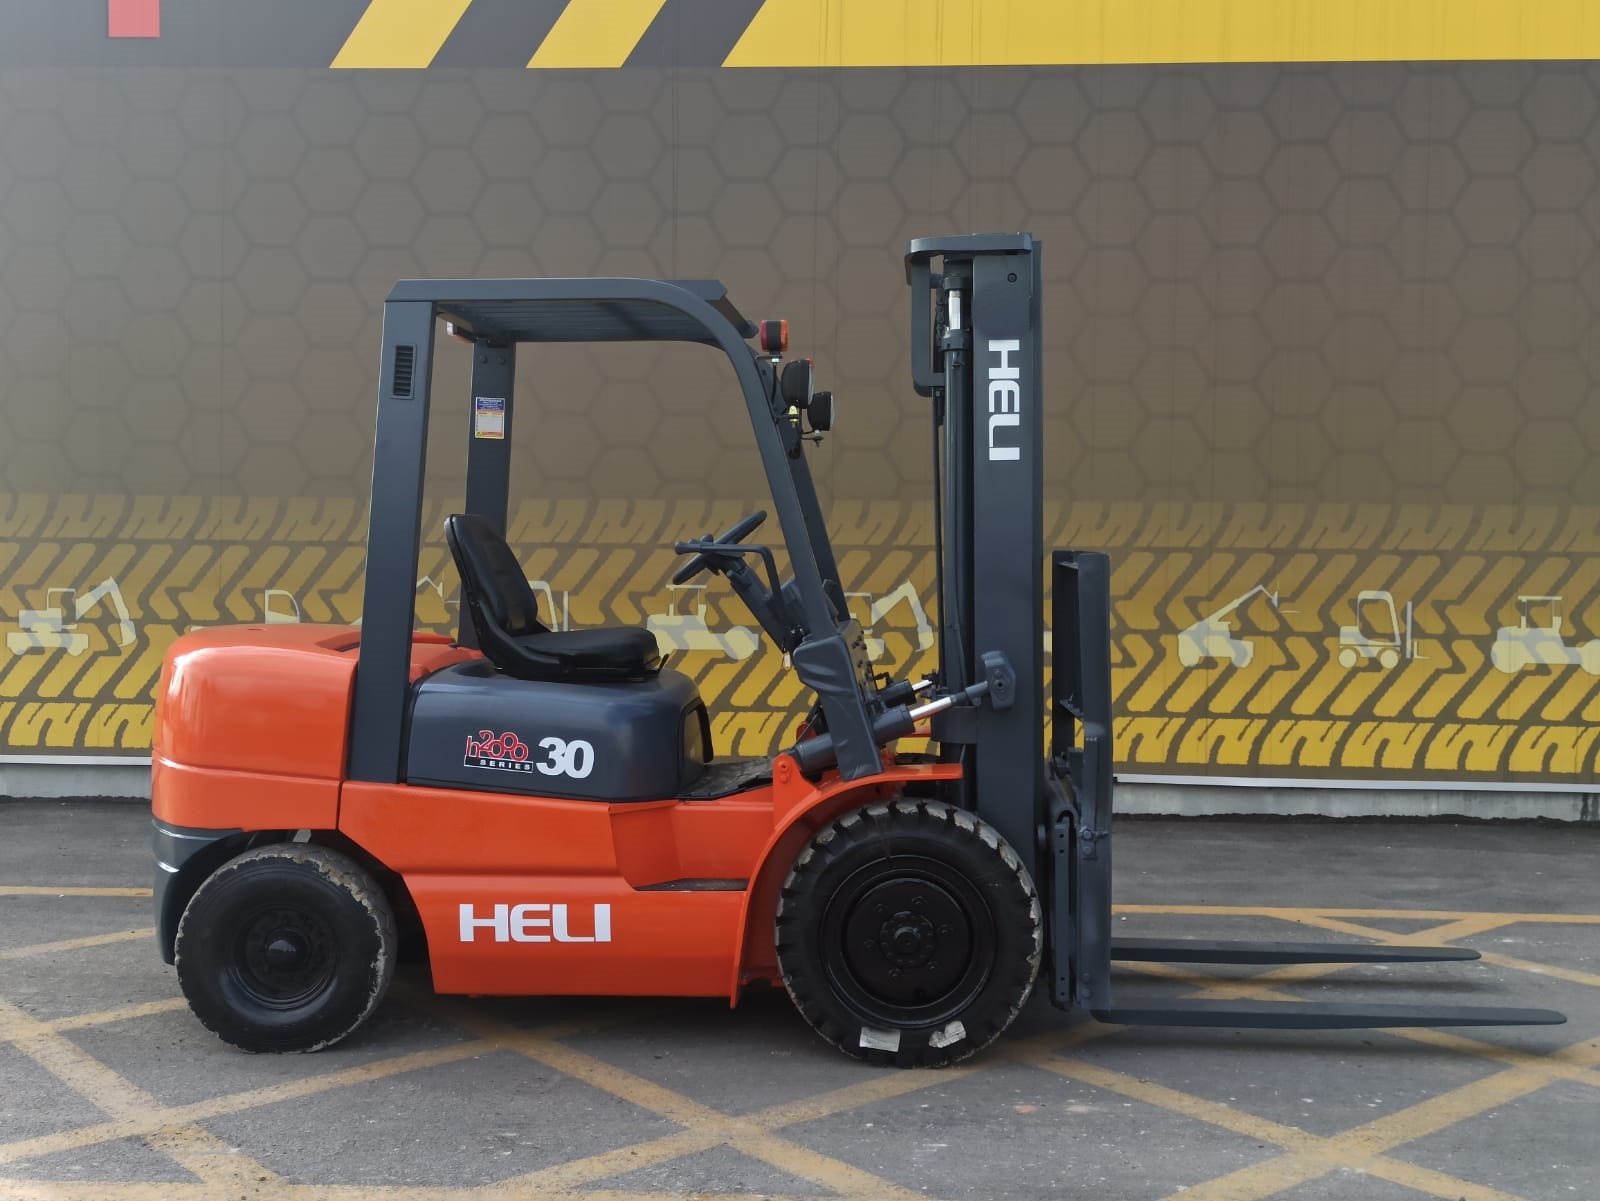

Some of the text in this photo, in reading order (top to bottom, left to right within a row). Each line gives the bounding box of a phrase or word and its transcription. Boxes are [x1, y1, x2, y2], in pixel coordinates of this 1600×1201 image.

[988, 339, 1020, 461] HELI
[480, 759, 531, 771] SERIES
[536, 737, 595, 779] 30
[459, 903, 612, 942] HELI
